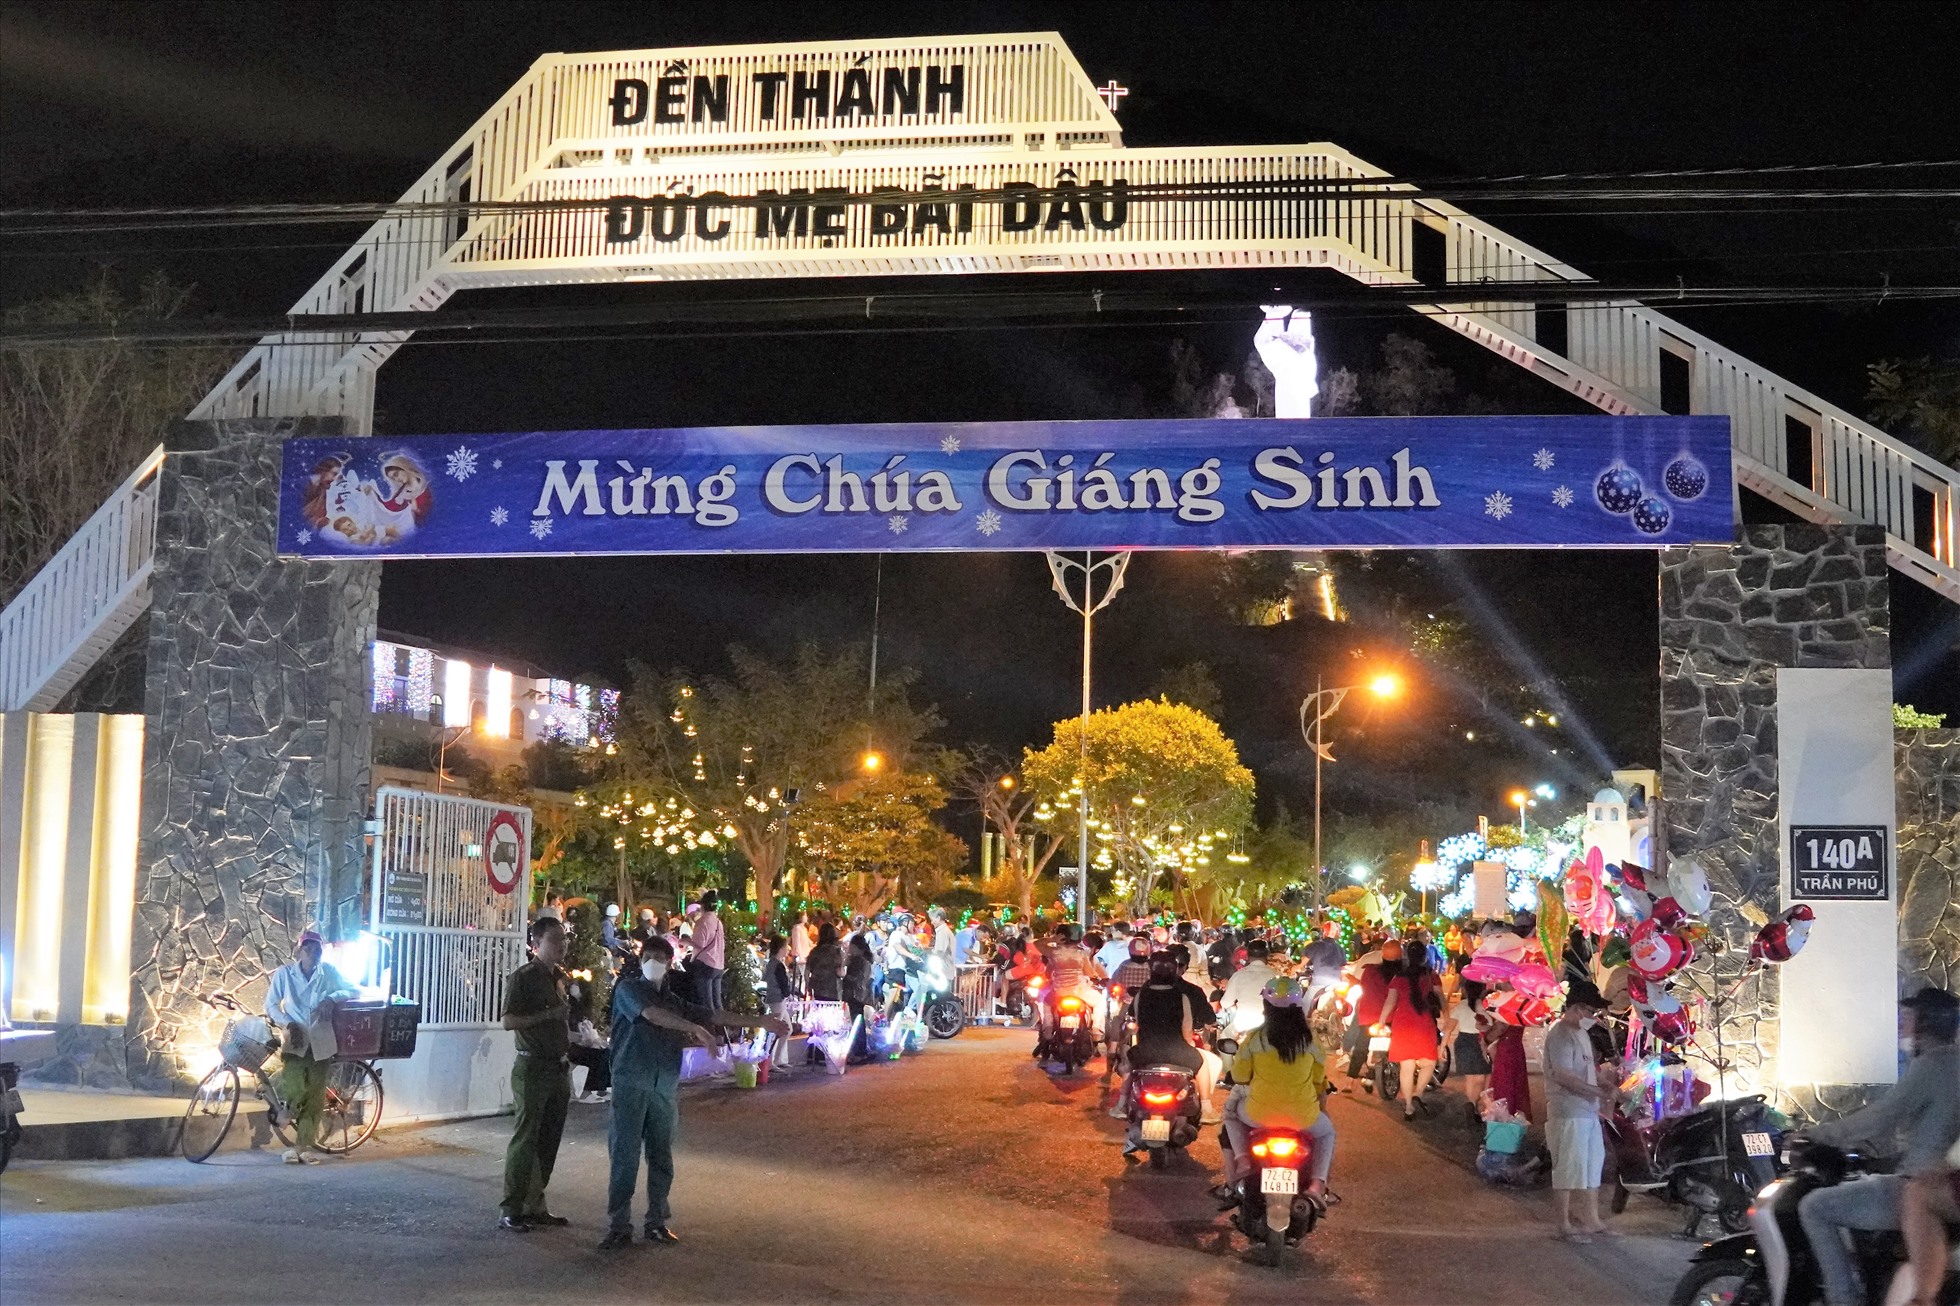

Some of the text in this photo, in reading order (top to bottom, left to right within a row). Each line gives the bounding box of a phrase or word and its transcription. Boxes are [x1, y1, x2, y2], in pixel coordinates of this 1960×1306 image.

[608, 55, 965, 126] ĐỀN THÁNH
[605, 168, 1128, 248] ĐỨC MẸ BÃI DÂU
[532, 446, 1442, 527] Mừng Chúa Giáng Sinh
[1806, 836, 1873, 869] 140A
[1847, 875, 1878, 890] PHÚ
